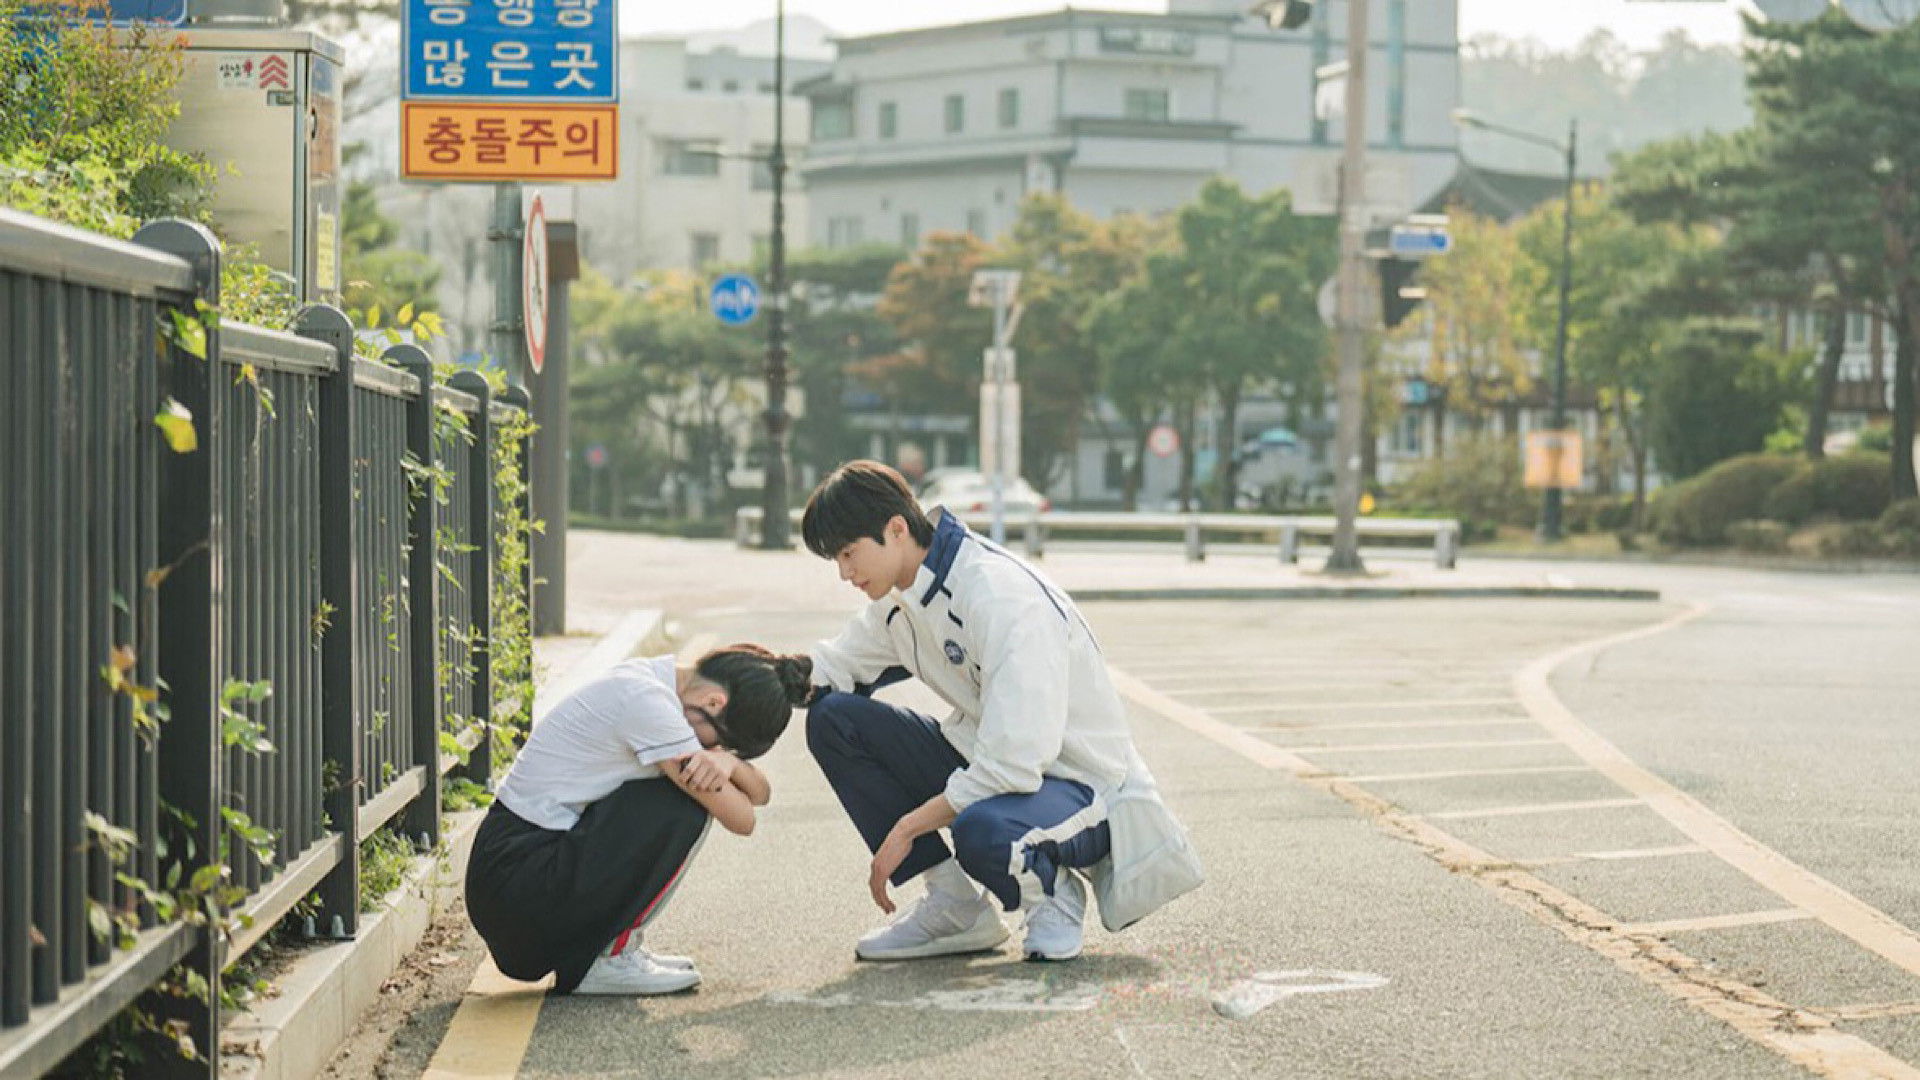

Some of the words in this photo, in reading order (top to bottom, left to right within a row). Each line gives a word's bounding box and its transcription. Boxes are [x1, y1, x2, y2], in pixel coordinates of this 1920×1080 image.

[422, 38, 535, 89] 많은
[550, 41, 600, 90] 곳
[422, 116, 600, 166] 충돌주의
